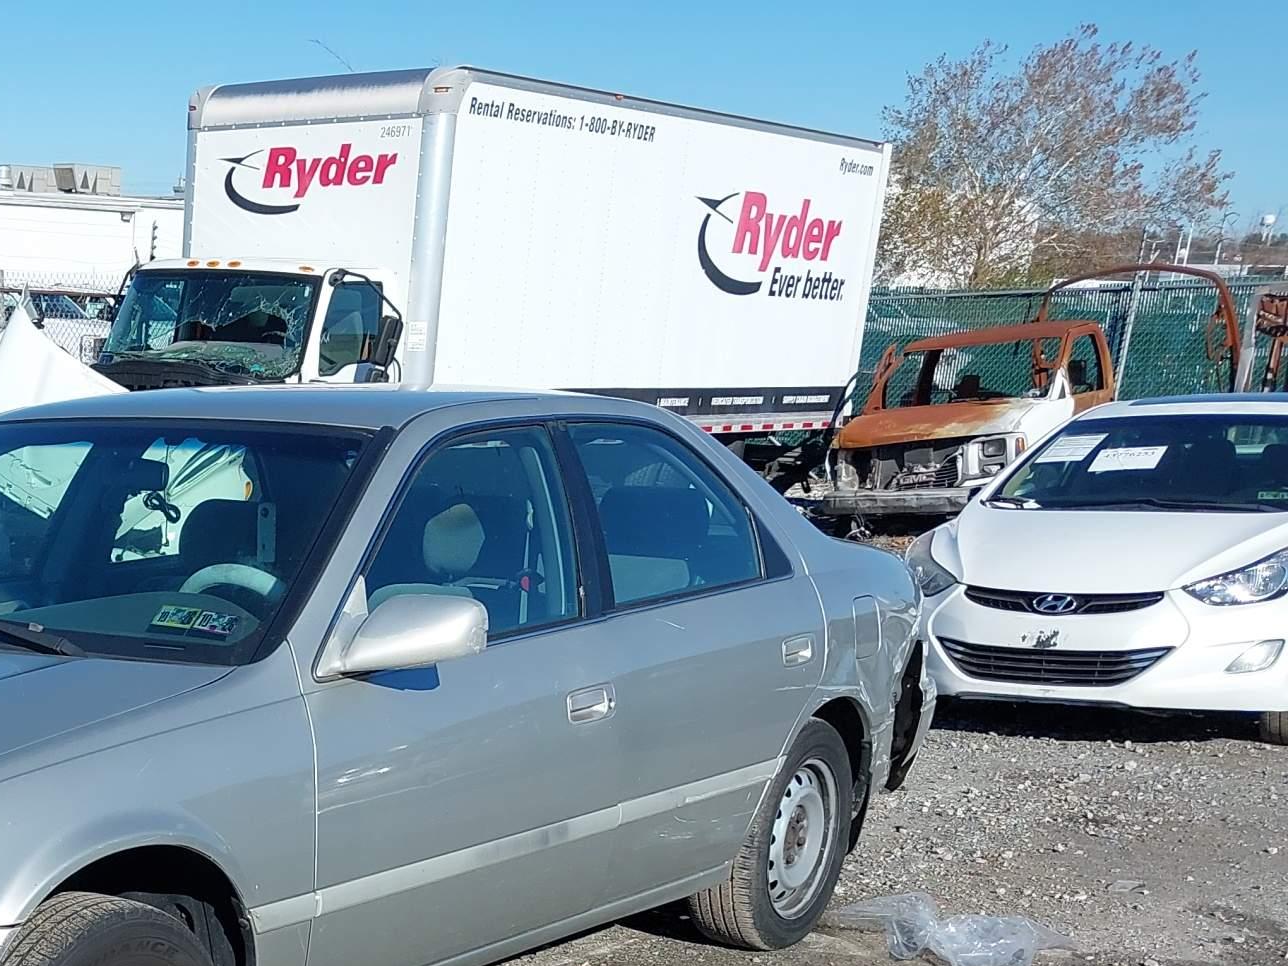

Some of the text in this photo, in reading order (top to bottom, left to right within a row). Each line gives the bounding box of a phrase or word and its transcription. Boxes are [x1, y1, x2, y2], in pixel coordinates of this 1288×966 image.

[380, 125, 411, 138] 246971
[469, 97, 657, 143] Rental Reservations: 1-800-BY-RYDER
[262, 143, 398, 198] Ryder
[839, 157, 874, 176] Ryder.com
[732, 190, 843, 272] Ryder
[768, 266, 845, 301] Ever better.
